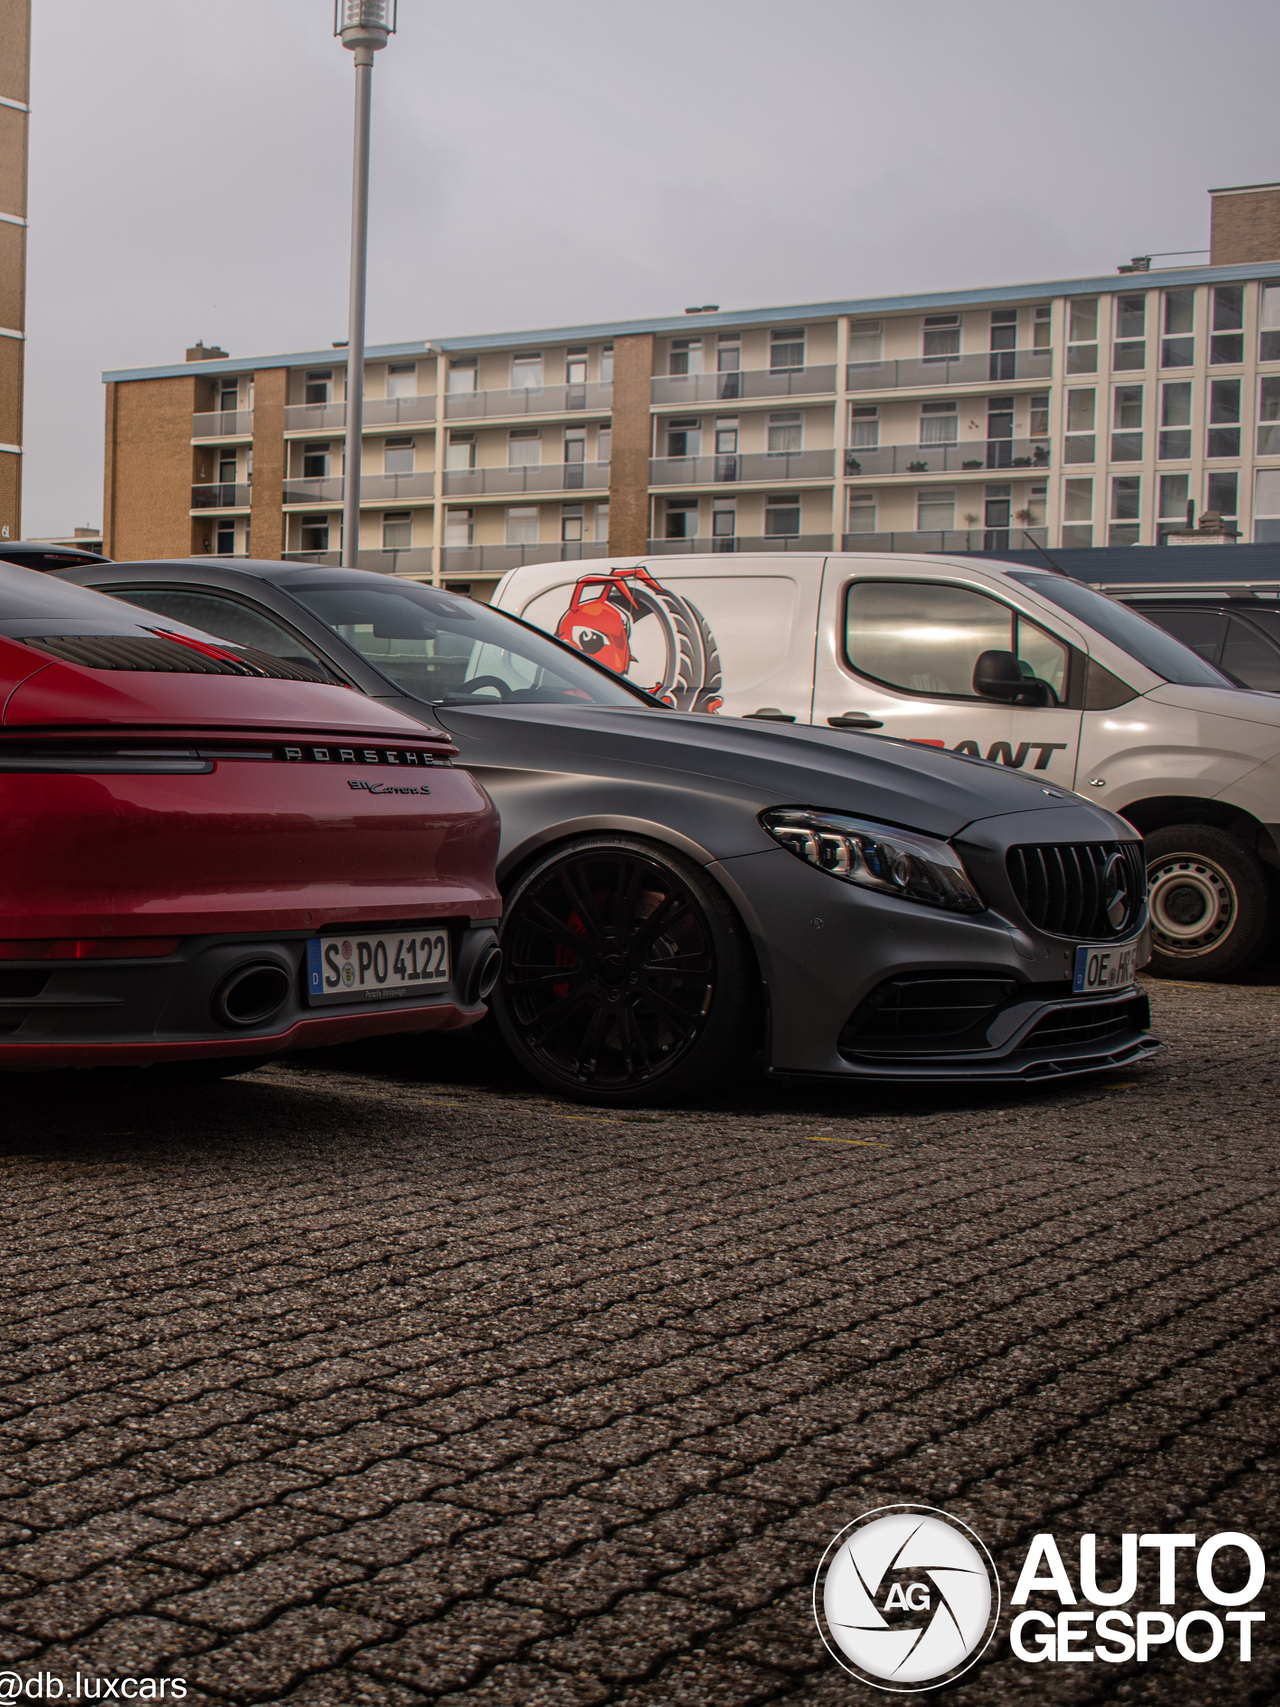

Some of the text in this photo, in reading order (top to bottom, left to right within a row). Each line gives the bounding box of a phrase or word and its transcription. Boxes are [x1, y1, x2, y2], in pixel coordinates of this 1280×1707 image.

[283, 747, 435, 765] PORSCHE
[348, 780, 370, 790] 911
[312, 935, 447, 988] D S PO 4122
[1087, 952, 1111, 987] OE
[365, 988, 382, 999] Porsche
